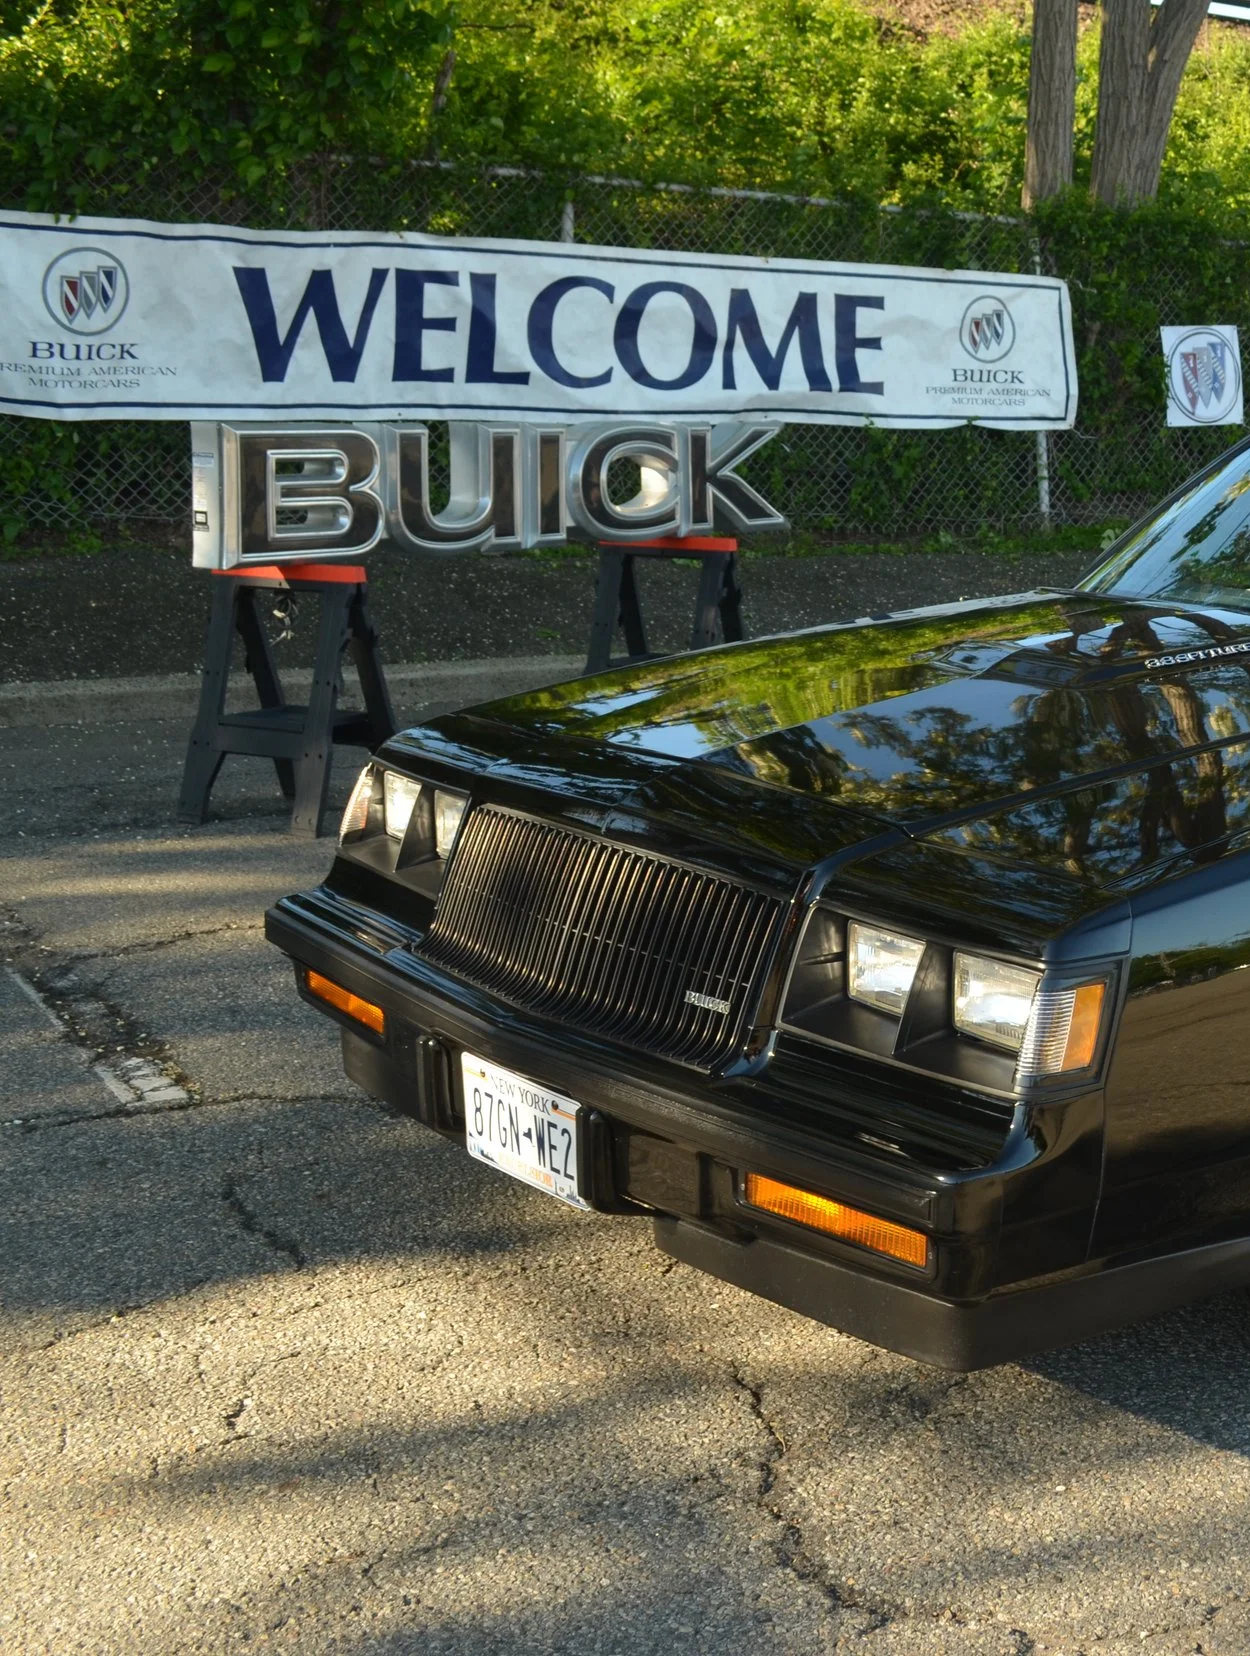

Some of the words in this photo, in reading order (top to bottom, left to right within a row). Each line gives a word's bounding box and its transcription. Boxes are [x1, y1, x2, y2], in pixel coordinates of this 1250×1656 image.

[232, 265, 886, 397] WELCOME
[29, 340, 140, 361] BUICK
[0, 362, 82, 377] REMIUM
[88, 366, 178, 377] AMERICAN
[951, 368, 1025, 385] BUICK
[28, 377, 141, 389] MOTORCARS
[925, 386, 983, 396] PREMIUM
[987, 388, 1051, 398] AMERICAN
[951, 397, 1026, 407] MOTORCARS
[219, 421, 790, 571] BUICK
[490, 1073, 517, 1098] NEW
[517, 1085, 552, 1116] YORK
